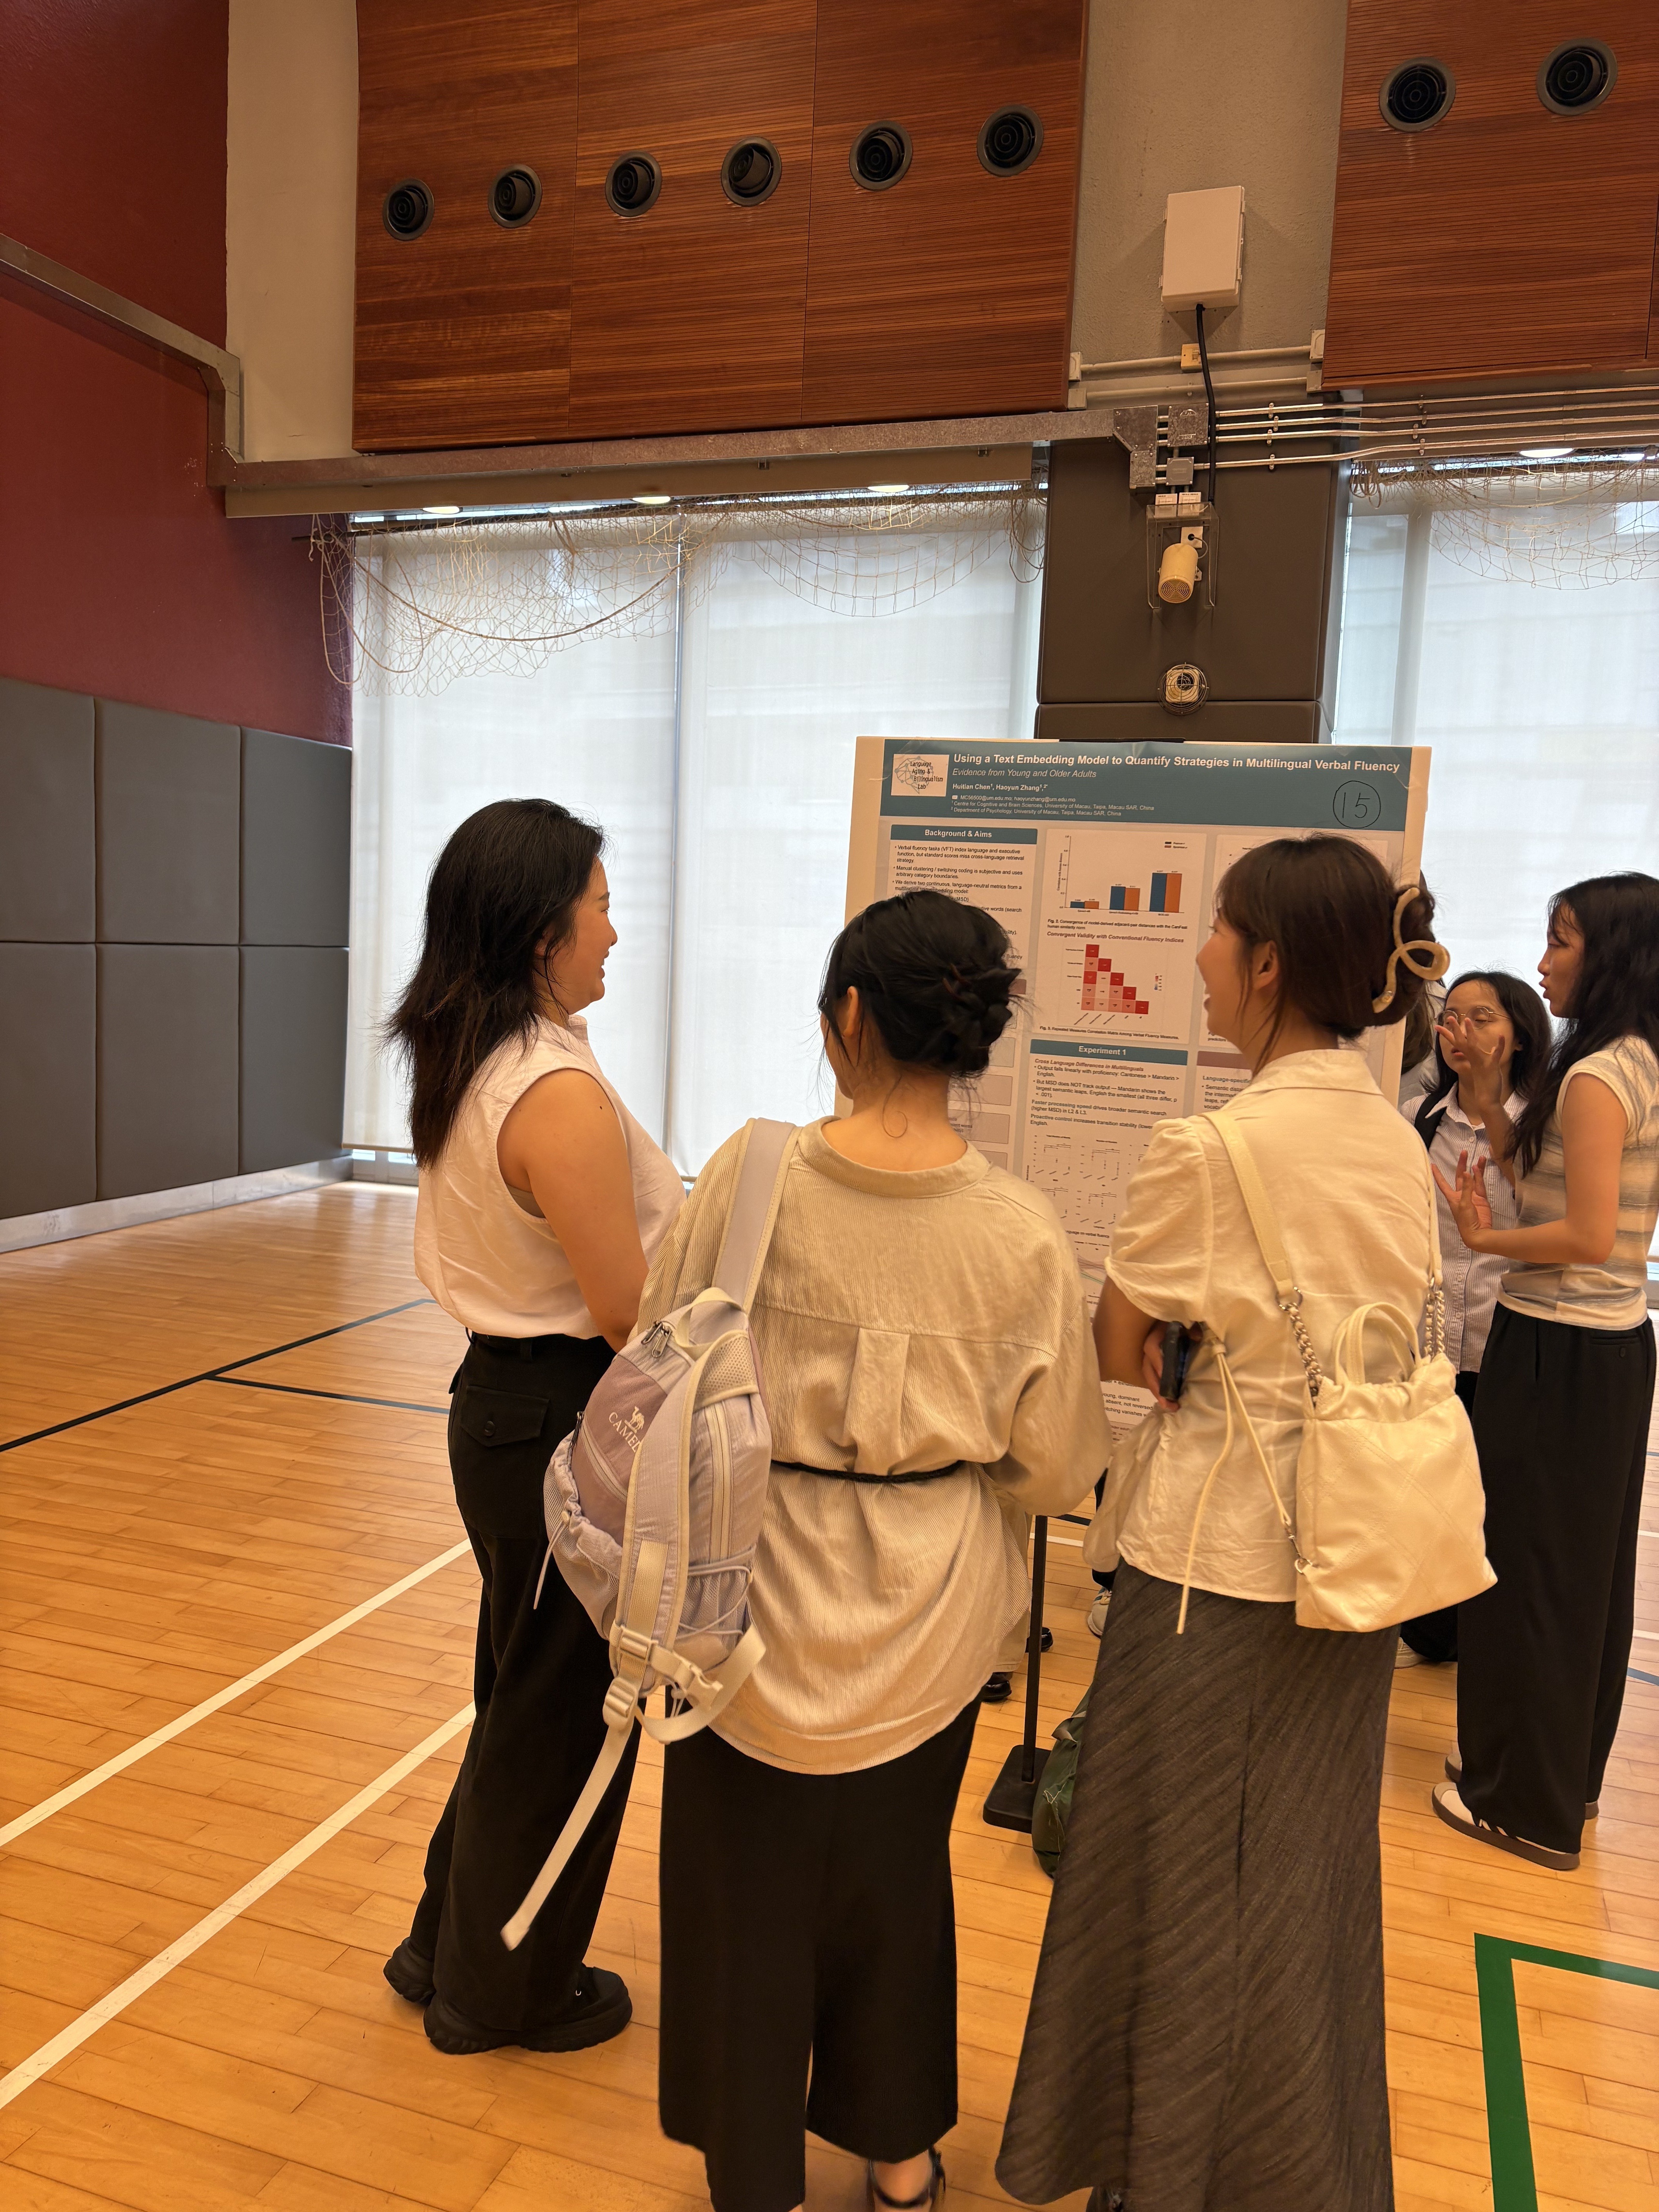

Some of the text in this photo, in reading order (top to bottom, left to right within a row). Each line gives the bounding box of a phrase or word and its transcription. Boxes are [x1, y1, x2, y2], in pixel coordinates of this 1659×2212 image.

[954, 754, 982, 764] Using
[993, 754, 1015, 763] Text
[1017, 754, 1074, 766] Embedding
[1077, 755, 1109, 764] Model
[1111, 756, 1122, 764] to
[1125, 756, 1171, 767] Quantify
[1174, 756, 1229, 768] Strategies
[1233, 758, 1242, 766] in
[1246, 758, 1311, 770] Multilingual
[1315, 760, 1350, 769] Verbal
[1354, 761, 1400, 773] Fluency
[1008, 769, 1030, 778] Young
[1343, 792, 1370, 818] 15
[925, 829, 965, 837] Background
[1079, 1046, 1120, 1055] Experiment
[609, 1412, 640, 1453] CAMEL
